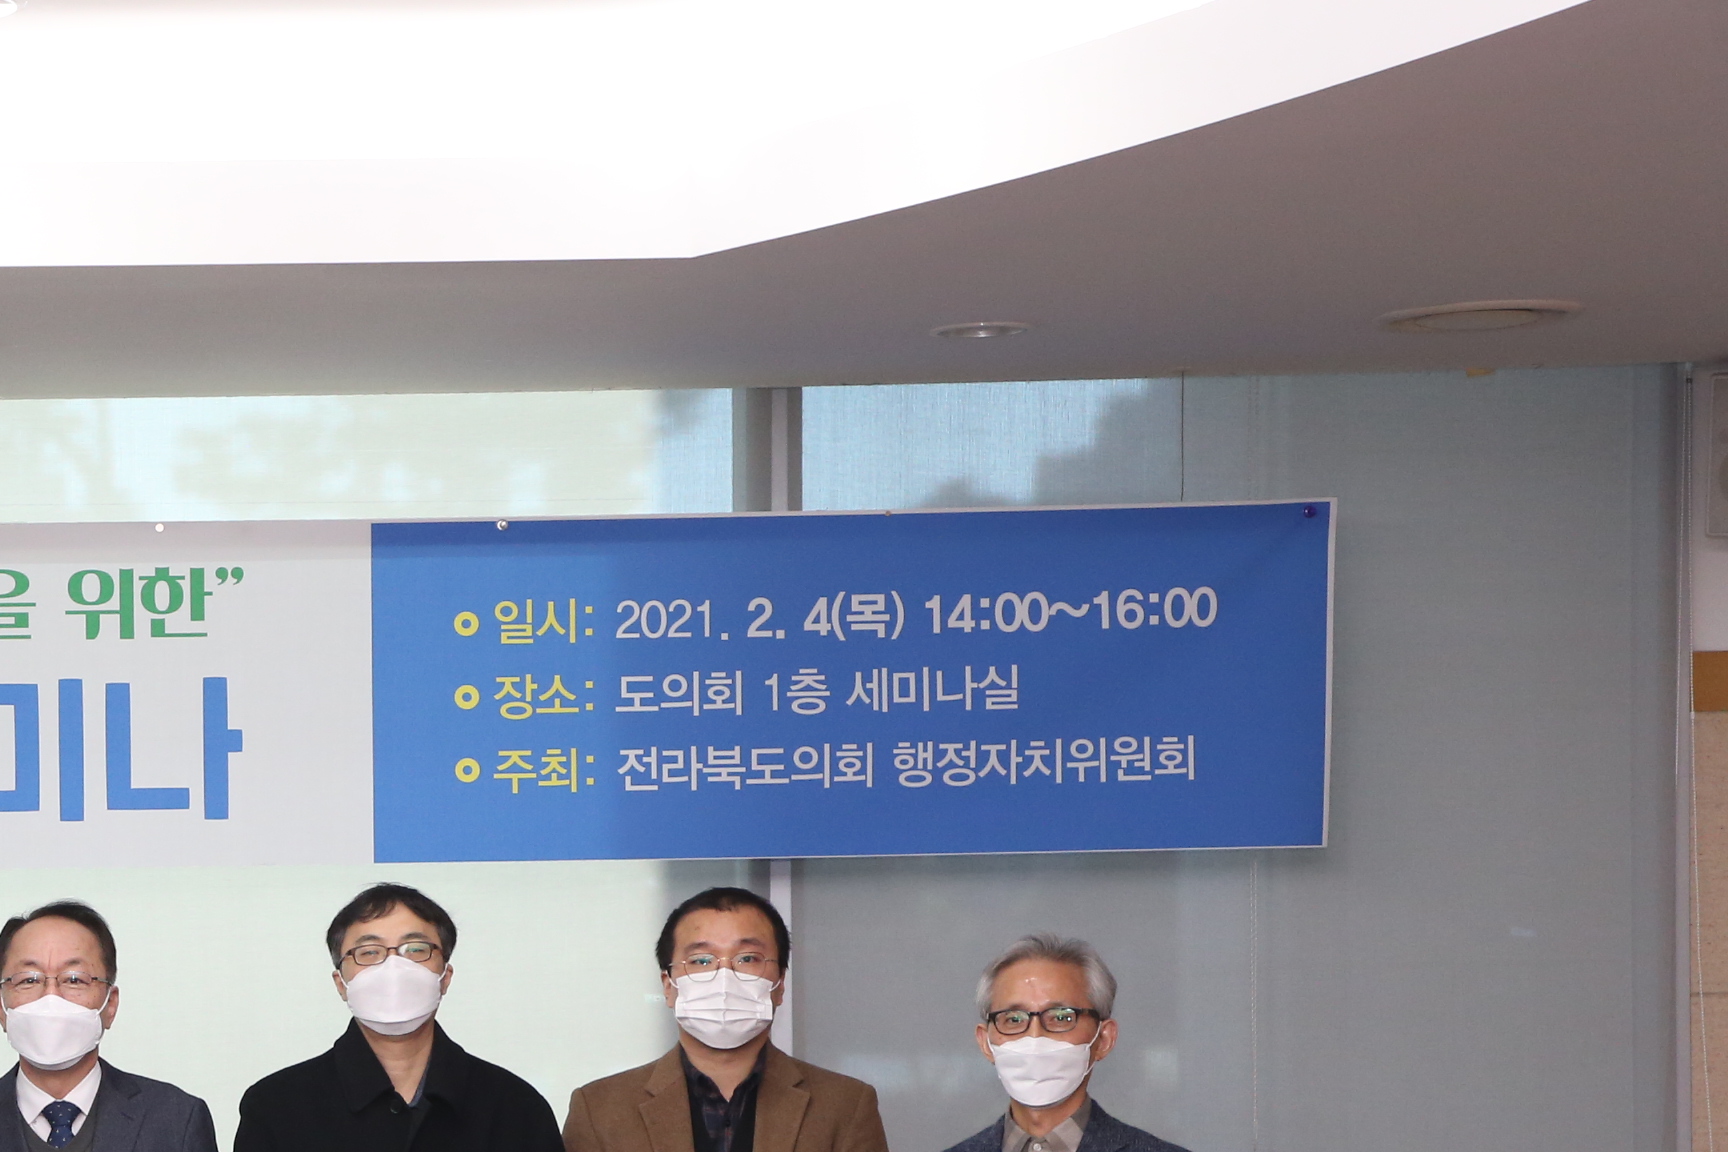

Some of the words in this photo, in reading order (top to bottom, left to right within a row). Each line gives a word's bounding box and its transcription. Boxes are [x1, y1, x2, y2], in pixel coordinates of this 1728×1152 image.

[494, 598, 595, 645] 일시:
[615, 599, 730, 641] 2021.
[746, 597, 786, 640] 2.
[803, 590, 906, 641] 4(목)
[925, 585, 1219, 634] 14:00~16:00
[494, 674, 595, 720] 장소:
[614, 670, 743, 717] 도의회
[764, 667, 830, 715] 1층
[845, 663, 1019, 713] 세미나실
[494, 748, 596, 794] 주최:
[616, 742, 874, 792] 전라북도의회
[892, 735, 1196, 789] 행정자치위원회
